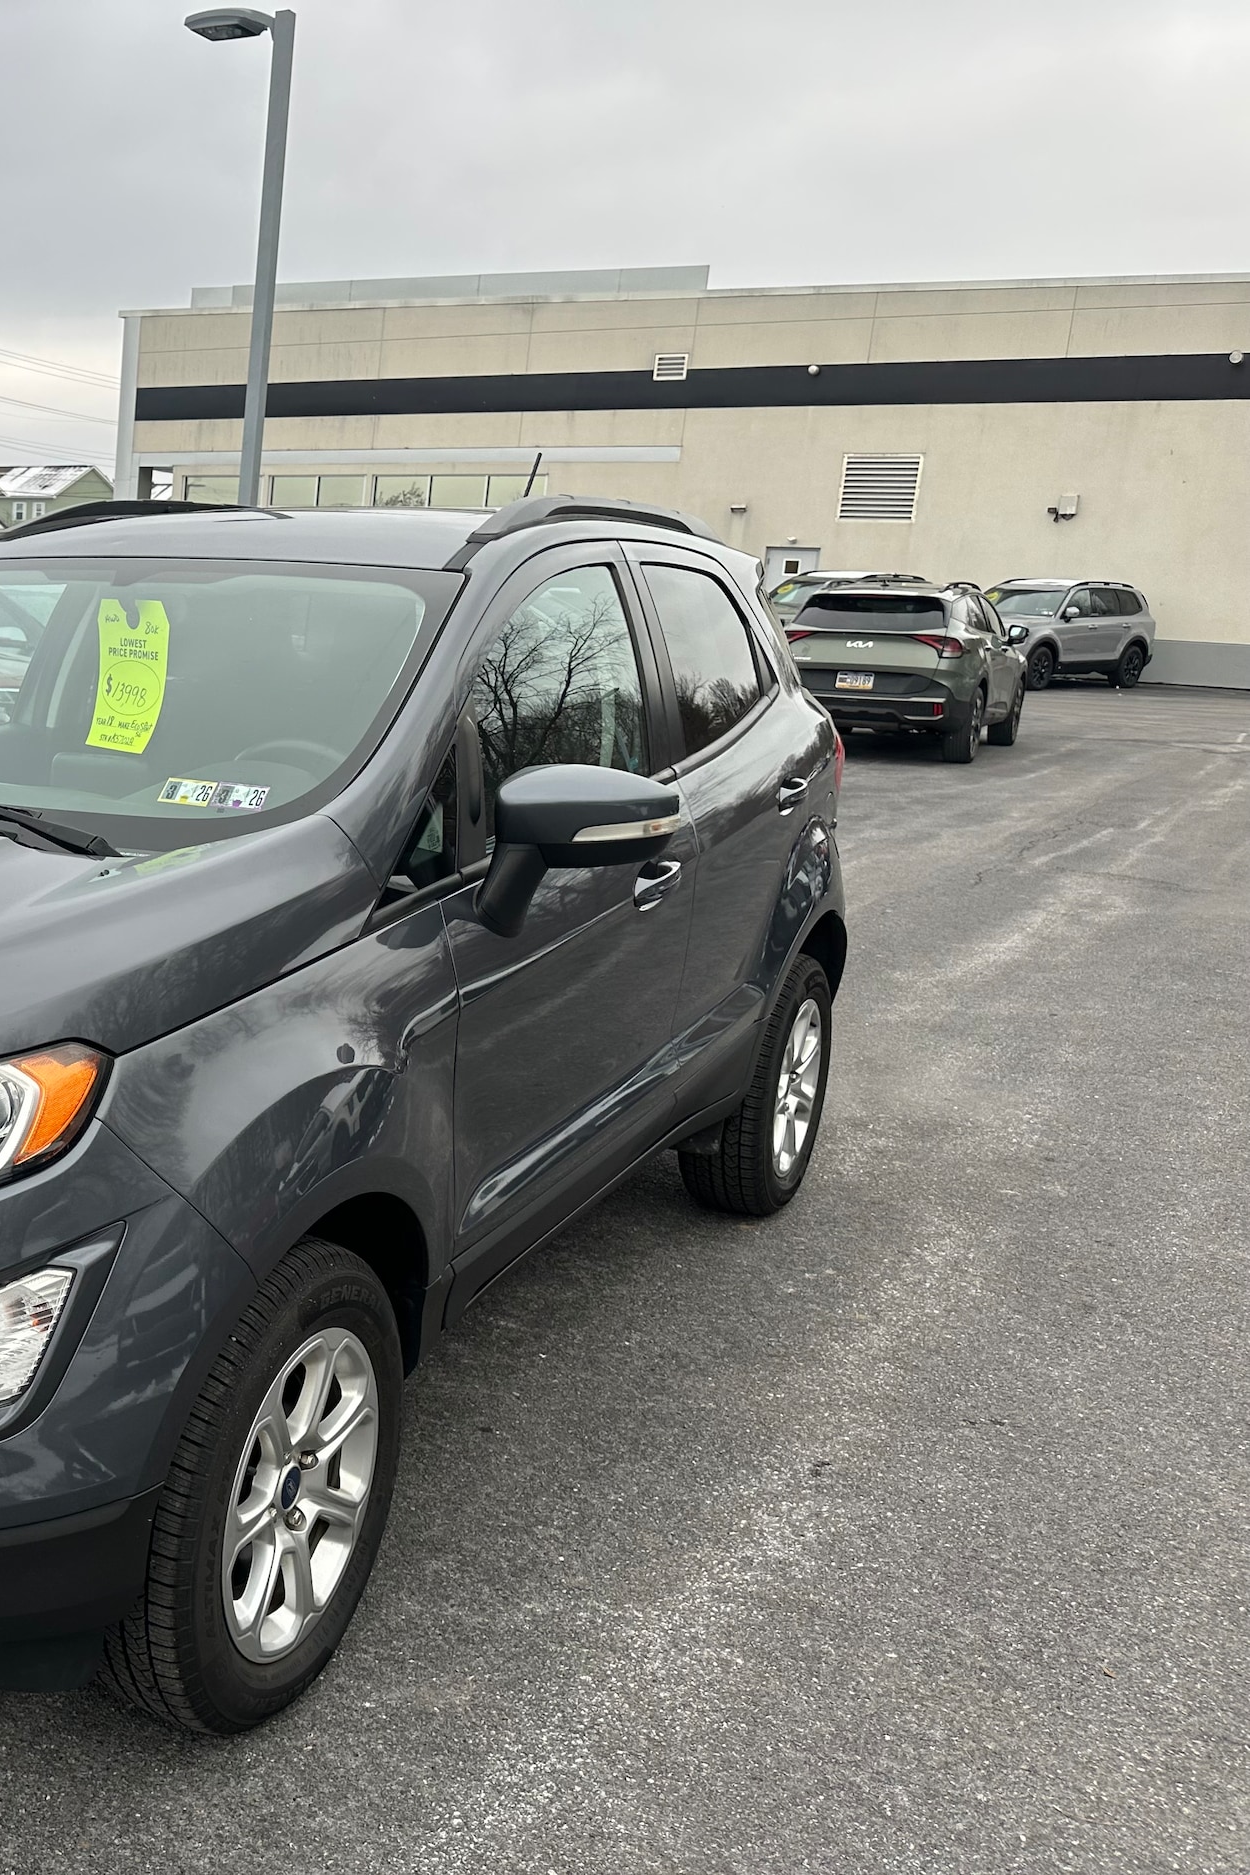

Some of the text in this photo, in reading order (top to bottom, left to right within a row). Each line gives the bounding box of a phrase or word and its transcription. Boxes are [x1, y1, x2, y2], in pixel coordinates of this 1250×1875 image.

[120, 638, 147, 648] LOWEST
[108, 647, 159, 660] PRICE PROMISE
[96, 717, 106, 725] YEAR
[118, 721, 130, 729] MAKE
[196, 785, 212, 802] 26
[249, 789, 266, 806] 26
